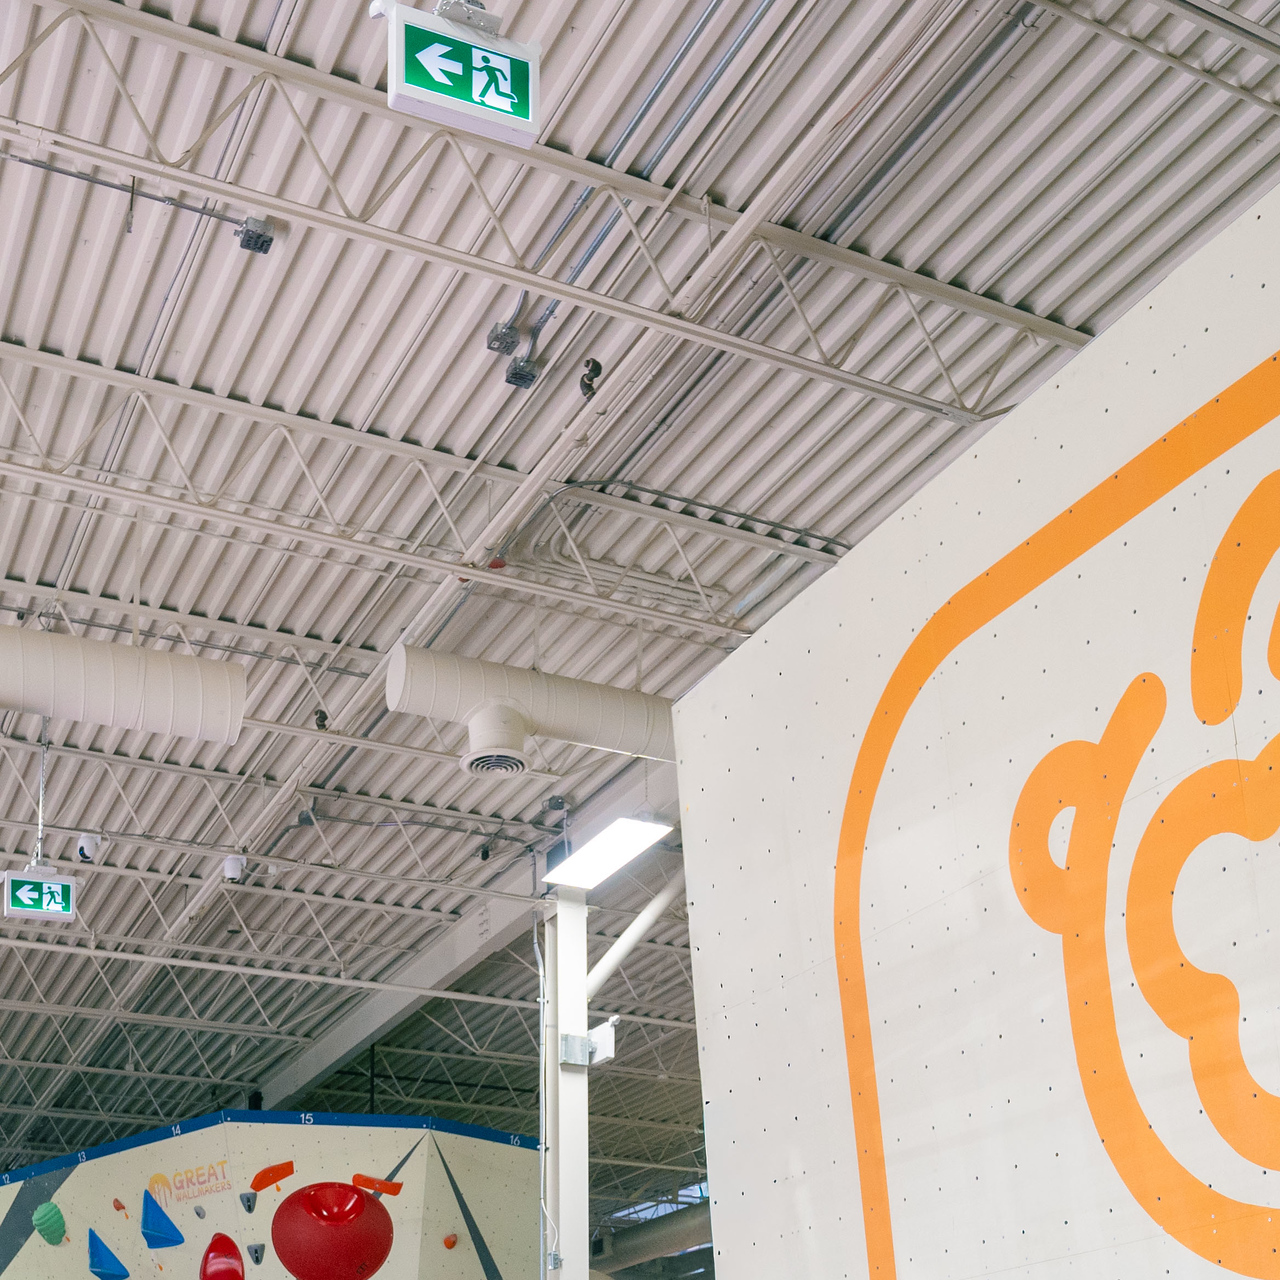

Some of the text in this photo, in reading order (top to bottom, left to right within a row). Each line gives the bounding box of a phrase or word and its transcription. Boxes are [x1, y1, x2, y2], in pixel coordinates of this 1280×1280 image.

[300, 1113, 314, 1125] 15
[171, 1124, 181, 1136] 14
[510, 1134, 521, 1146] 16
[77, 1151, 87, 1163] 13
[2, 1173, 11, 1184] 12
[173, 1160, 228, 1191] GREAT
[175, 1180, 232, 1203] WALLMAKERS
